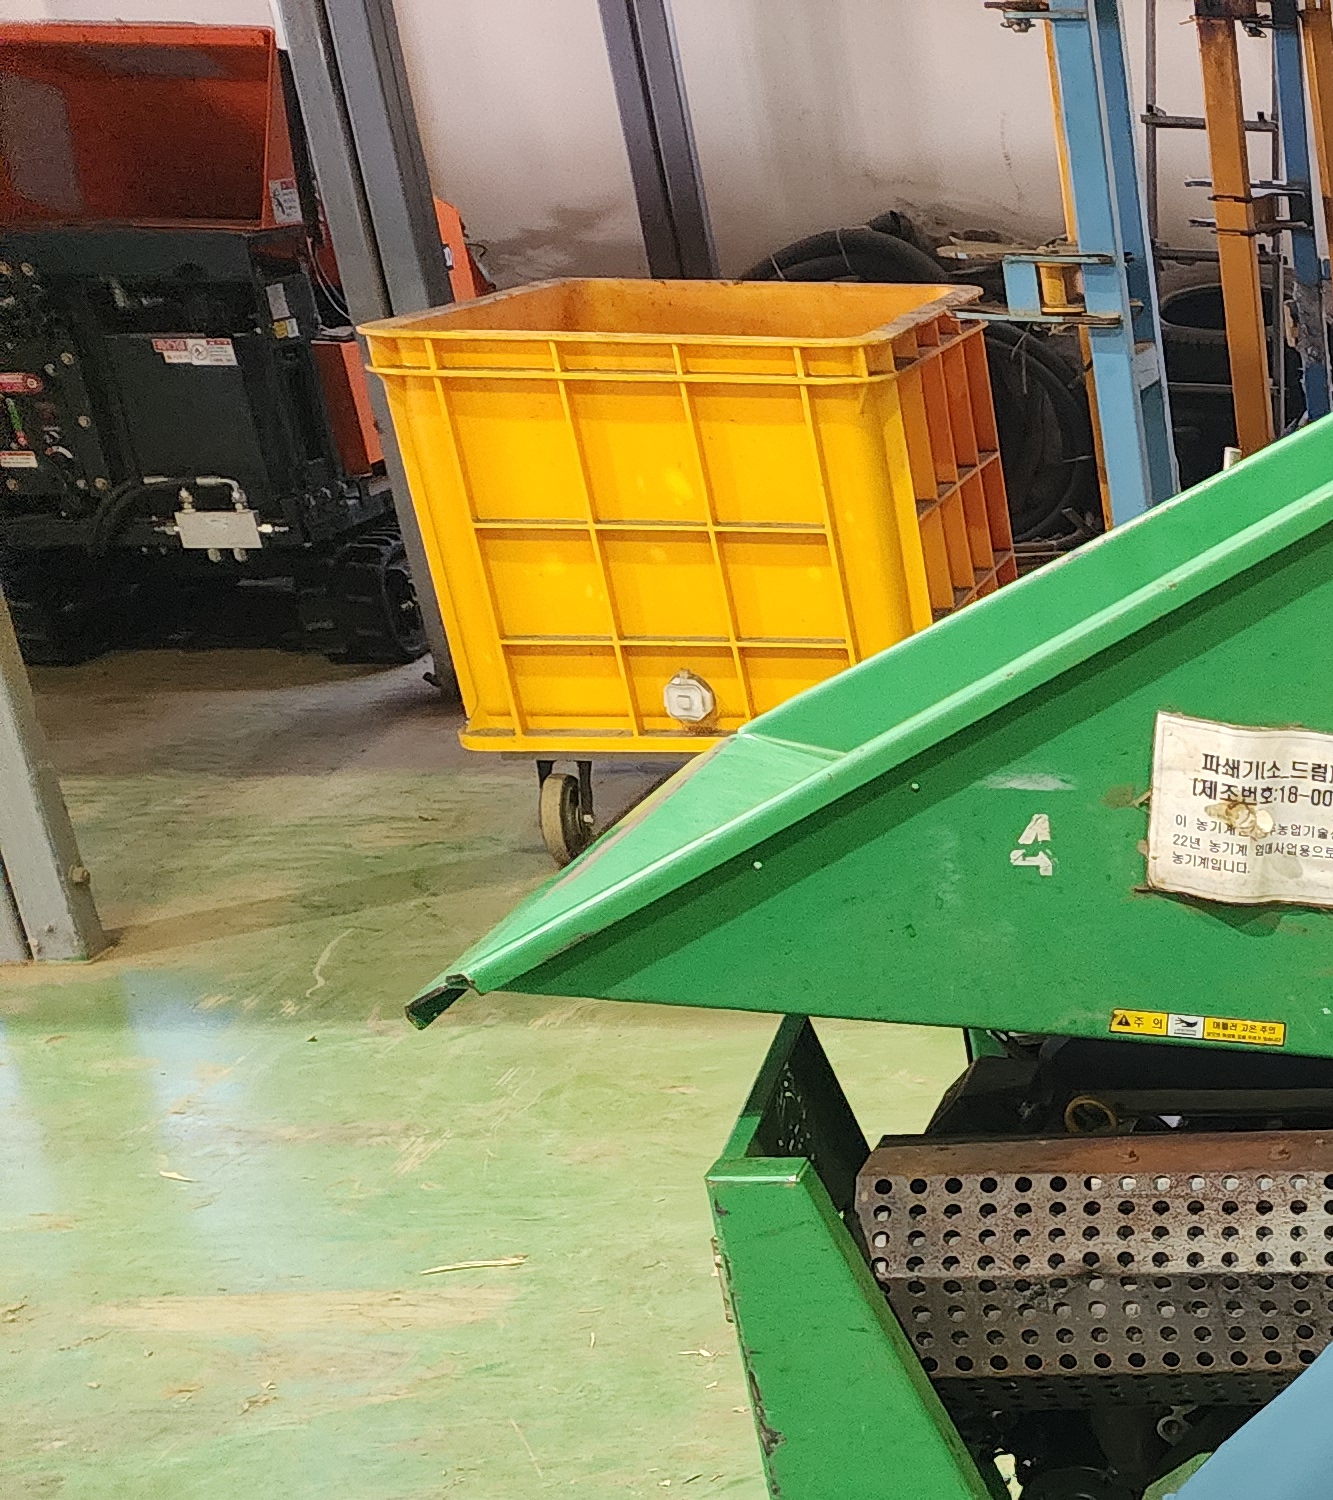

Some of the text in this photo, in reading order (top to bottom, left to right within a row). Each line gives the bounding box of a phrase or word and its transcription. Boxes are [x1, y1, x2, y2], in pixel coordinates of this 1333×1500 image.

[1174, 814, 1187, 828] 이
[1172, 833, 1201, 850] 22년
[1209, 840, 1247, 857] 농기계
[1172, 851, 1251, 874] 농기계입니다.
[1240, 1023, 1257, 1033] 고온
[1259, 1025, 1276, 1035] 주의
